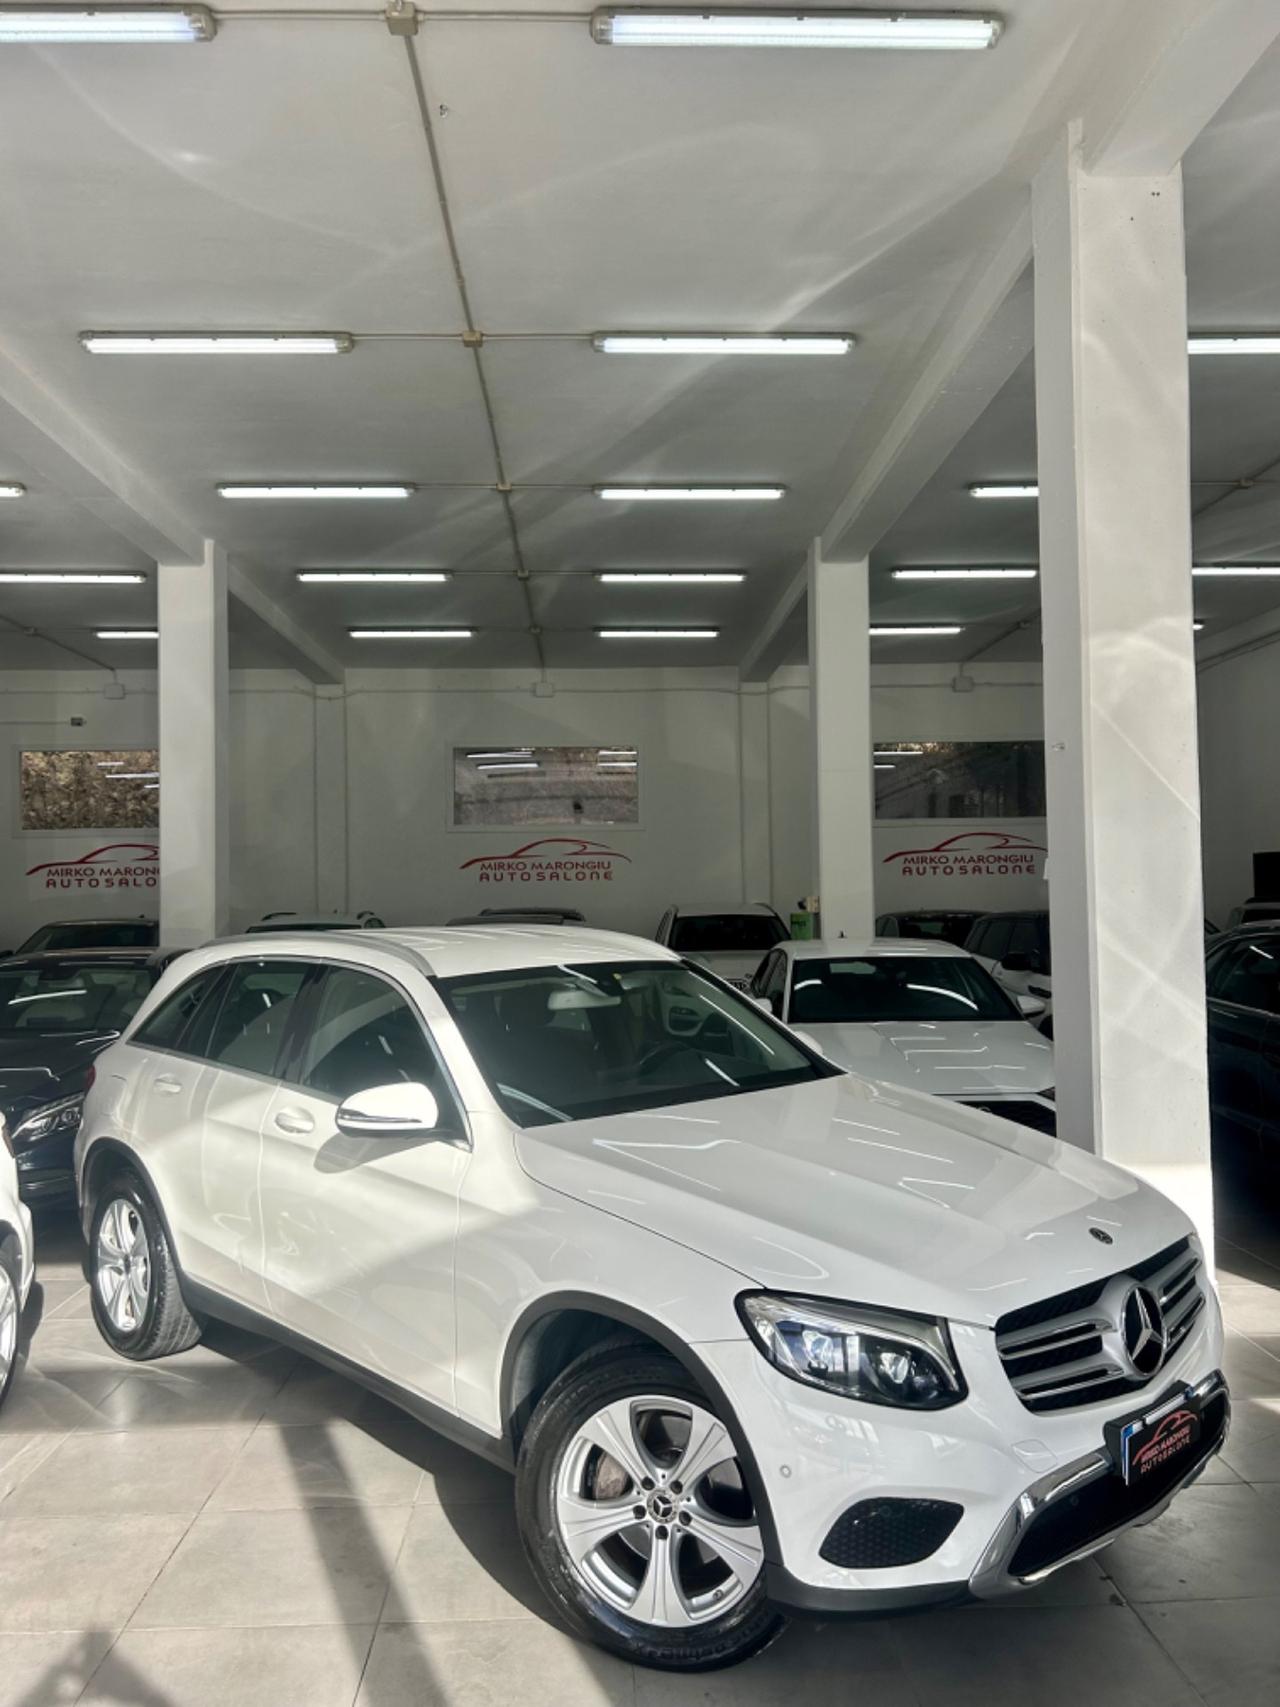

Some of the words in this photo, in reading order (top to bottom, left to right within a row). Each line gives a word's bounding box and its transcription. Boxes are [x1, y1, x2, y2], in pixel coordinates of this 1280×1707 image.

[903, 855, 949, 864] MIRKO
[953, 854, 1034, 864] MARONGIU
[480, 861, 527, 871] MIRKO
[531, 860, 611, 870] MARONGIU
[902, 864, 1036, 876] AUTOSALONE
[47, 867, 95, 877] MIRKO
[99, 866, 160, 877] MARON
[479, 871, 613, 882] AUTOSALONE
[46, 877, 158, 888] AUTOSALO
